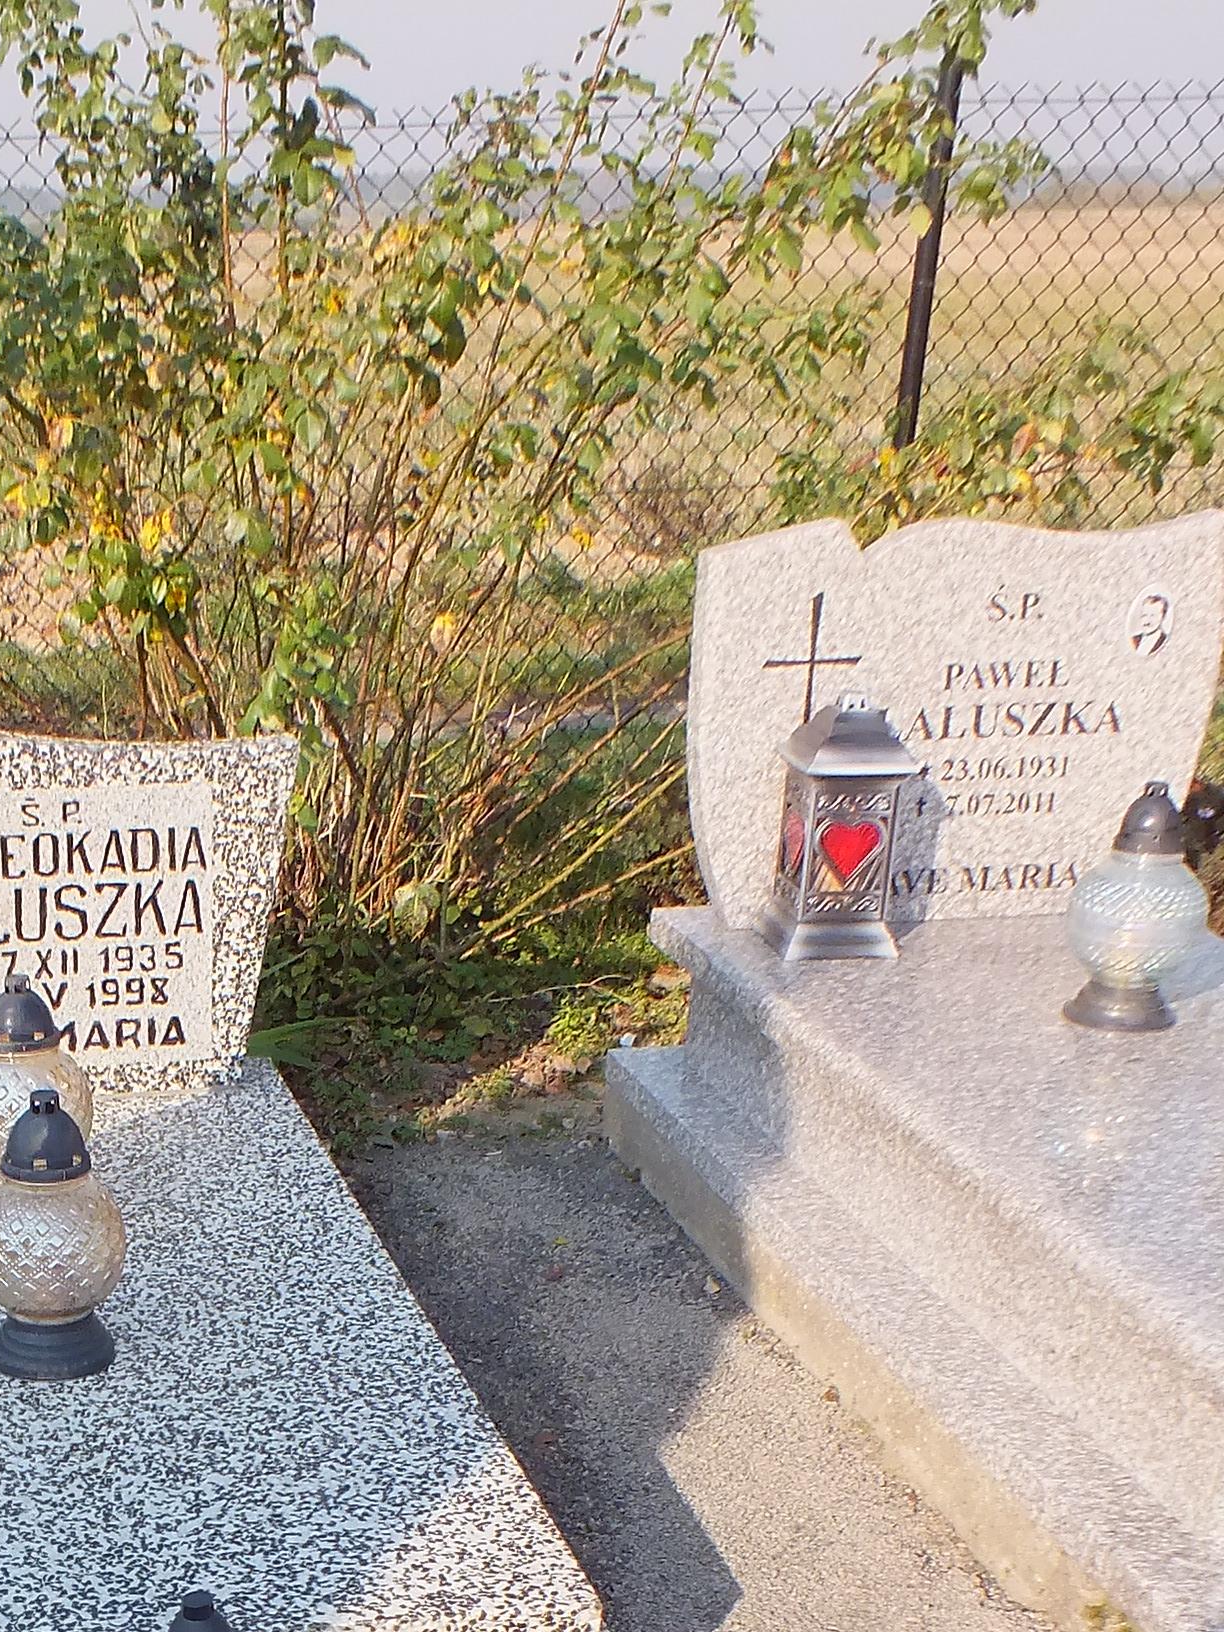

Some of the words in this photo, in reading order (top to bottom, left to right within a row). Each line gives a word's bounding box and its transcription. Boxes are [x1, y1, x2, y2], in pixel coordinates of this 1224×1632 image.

[944, 658, 1070, 690] PAWEŁ
[894, 700, 1122, 740] ALUSZKA
[940, 756, 1069, 781] 23.06.1931
[958, 860, 1078, 893] MARIA
[34, 947, 79, 980] XII
[98, 941, 184, 975] 1935
[85, 976, 170, 1010] 1998
